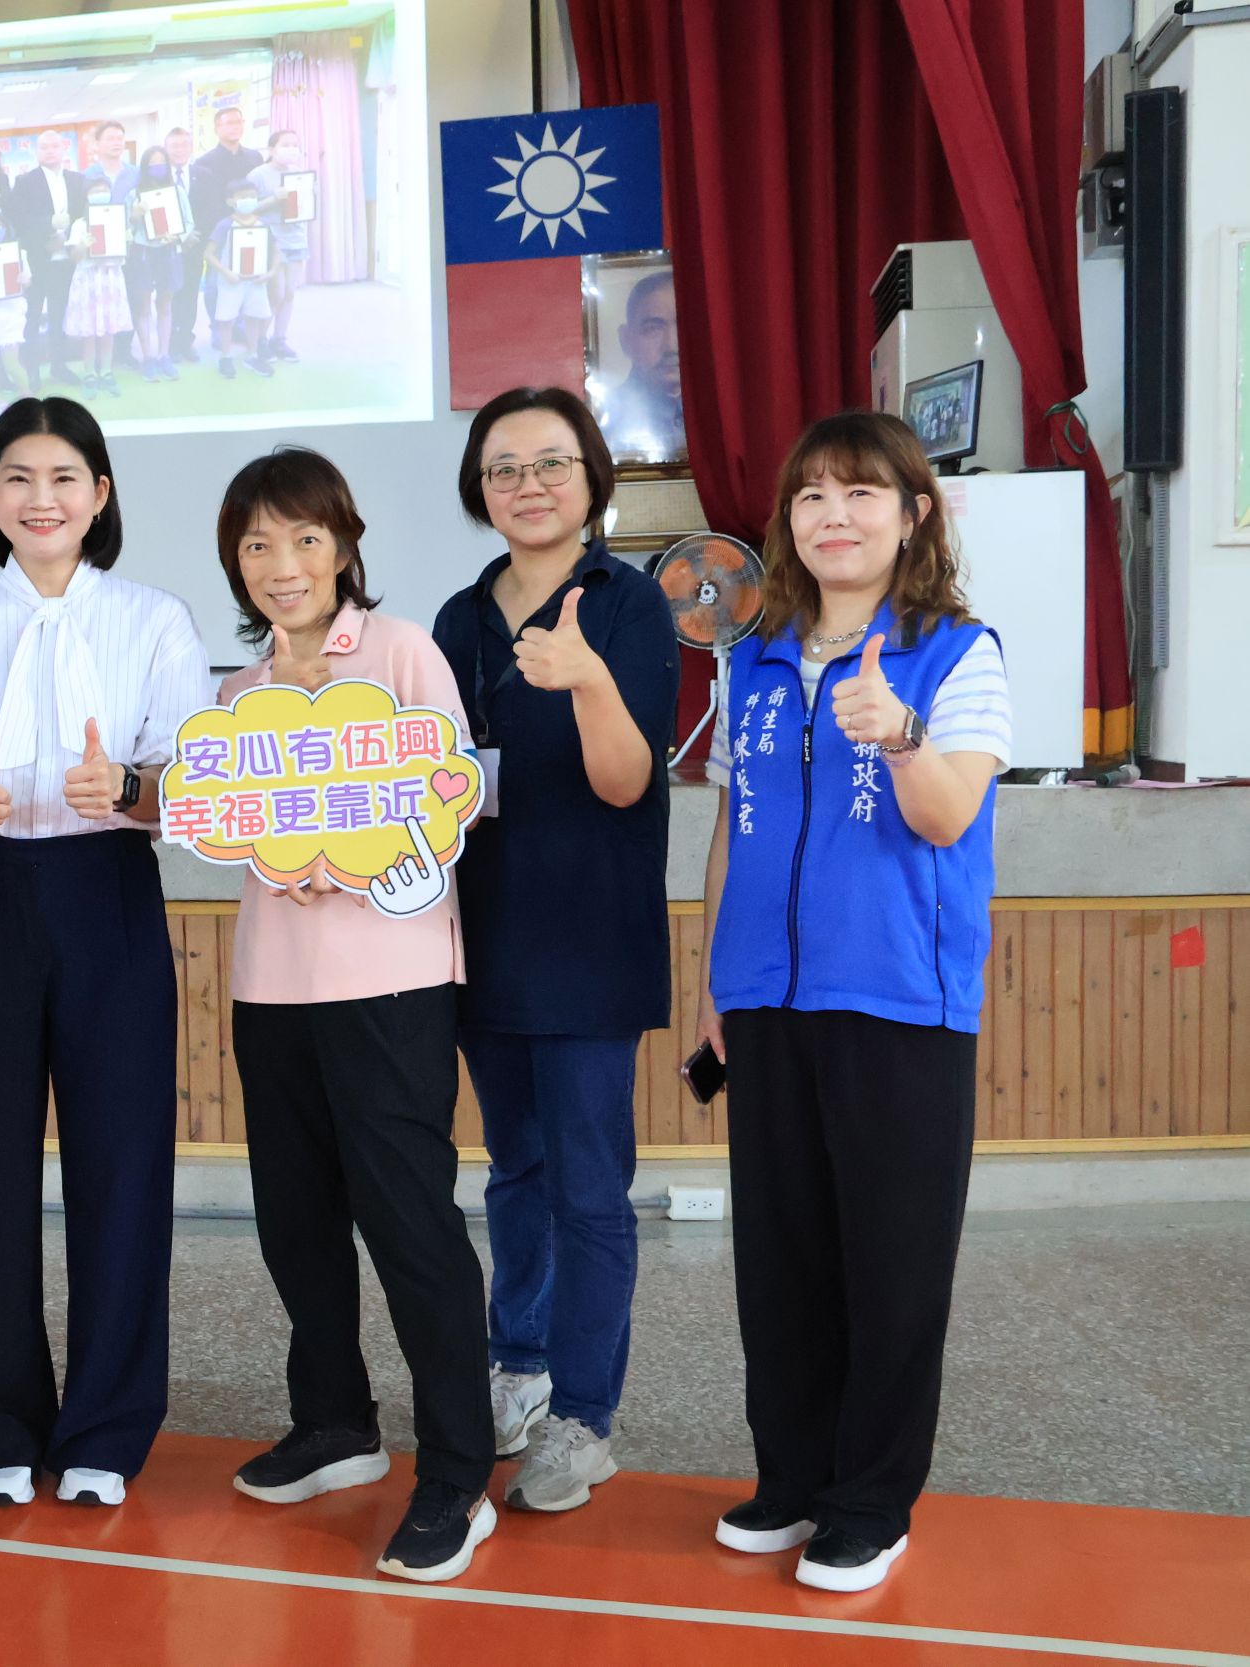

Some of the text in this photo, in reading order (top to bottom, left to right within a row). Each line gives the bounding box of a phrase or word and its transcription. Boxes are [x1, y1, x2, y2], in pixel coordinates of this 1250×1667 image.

[183, 718, 442, 782] 安心有伍興
[756, 685, 788, 755] 衛生局
[166, 778, 428, 842] 幸福更靠近
